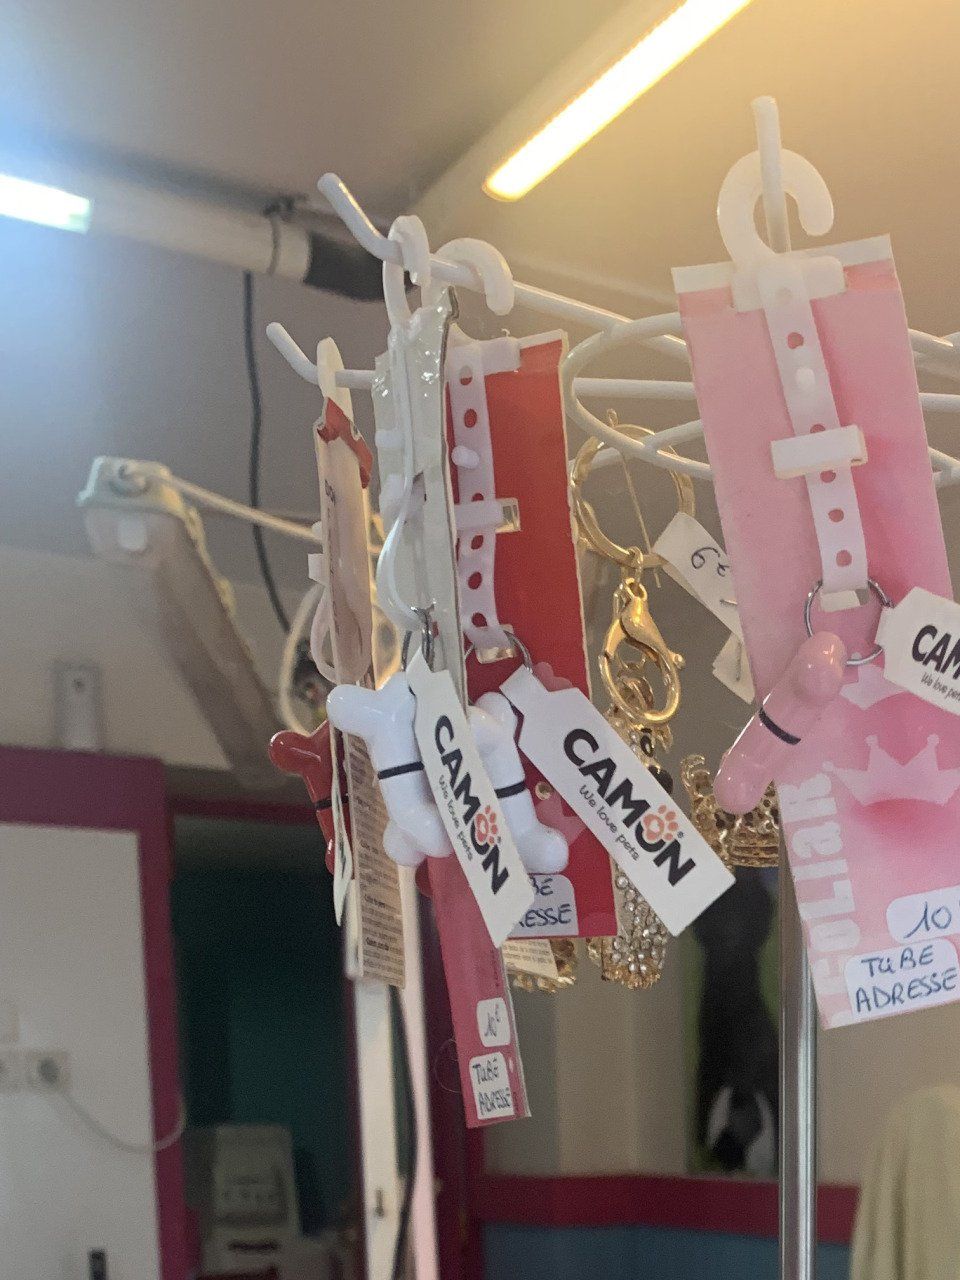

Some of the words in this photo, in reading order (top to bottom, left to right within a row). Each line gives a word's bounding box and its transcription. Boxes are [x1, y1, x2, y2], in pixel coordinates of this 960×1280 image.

[435, 715, 510, 894] CAMON
[563, 728, 697, 887] CAMON
[578, 784, 597, 806] We
[596, 805, 618, 835] love
[855, 968, 958, 1013] ADRESSE
